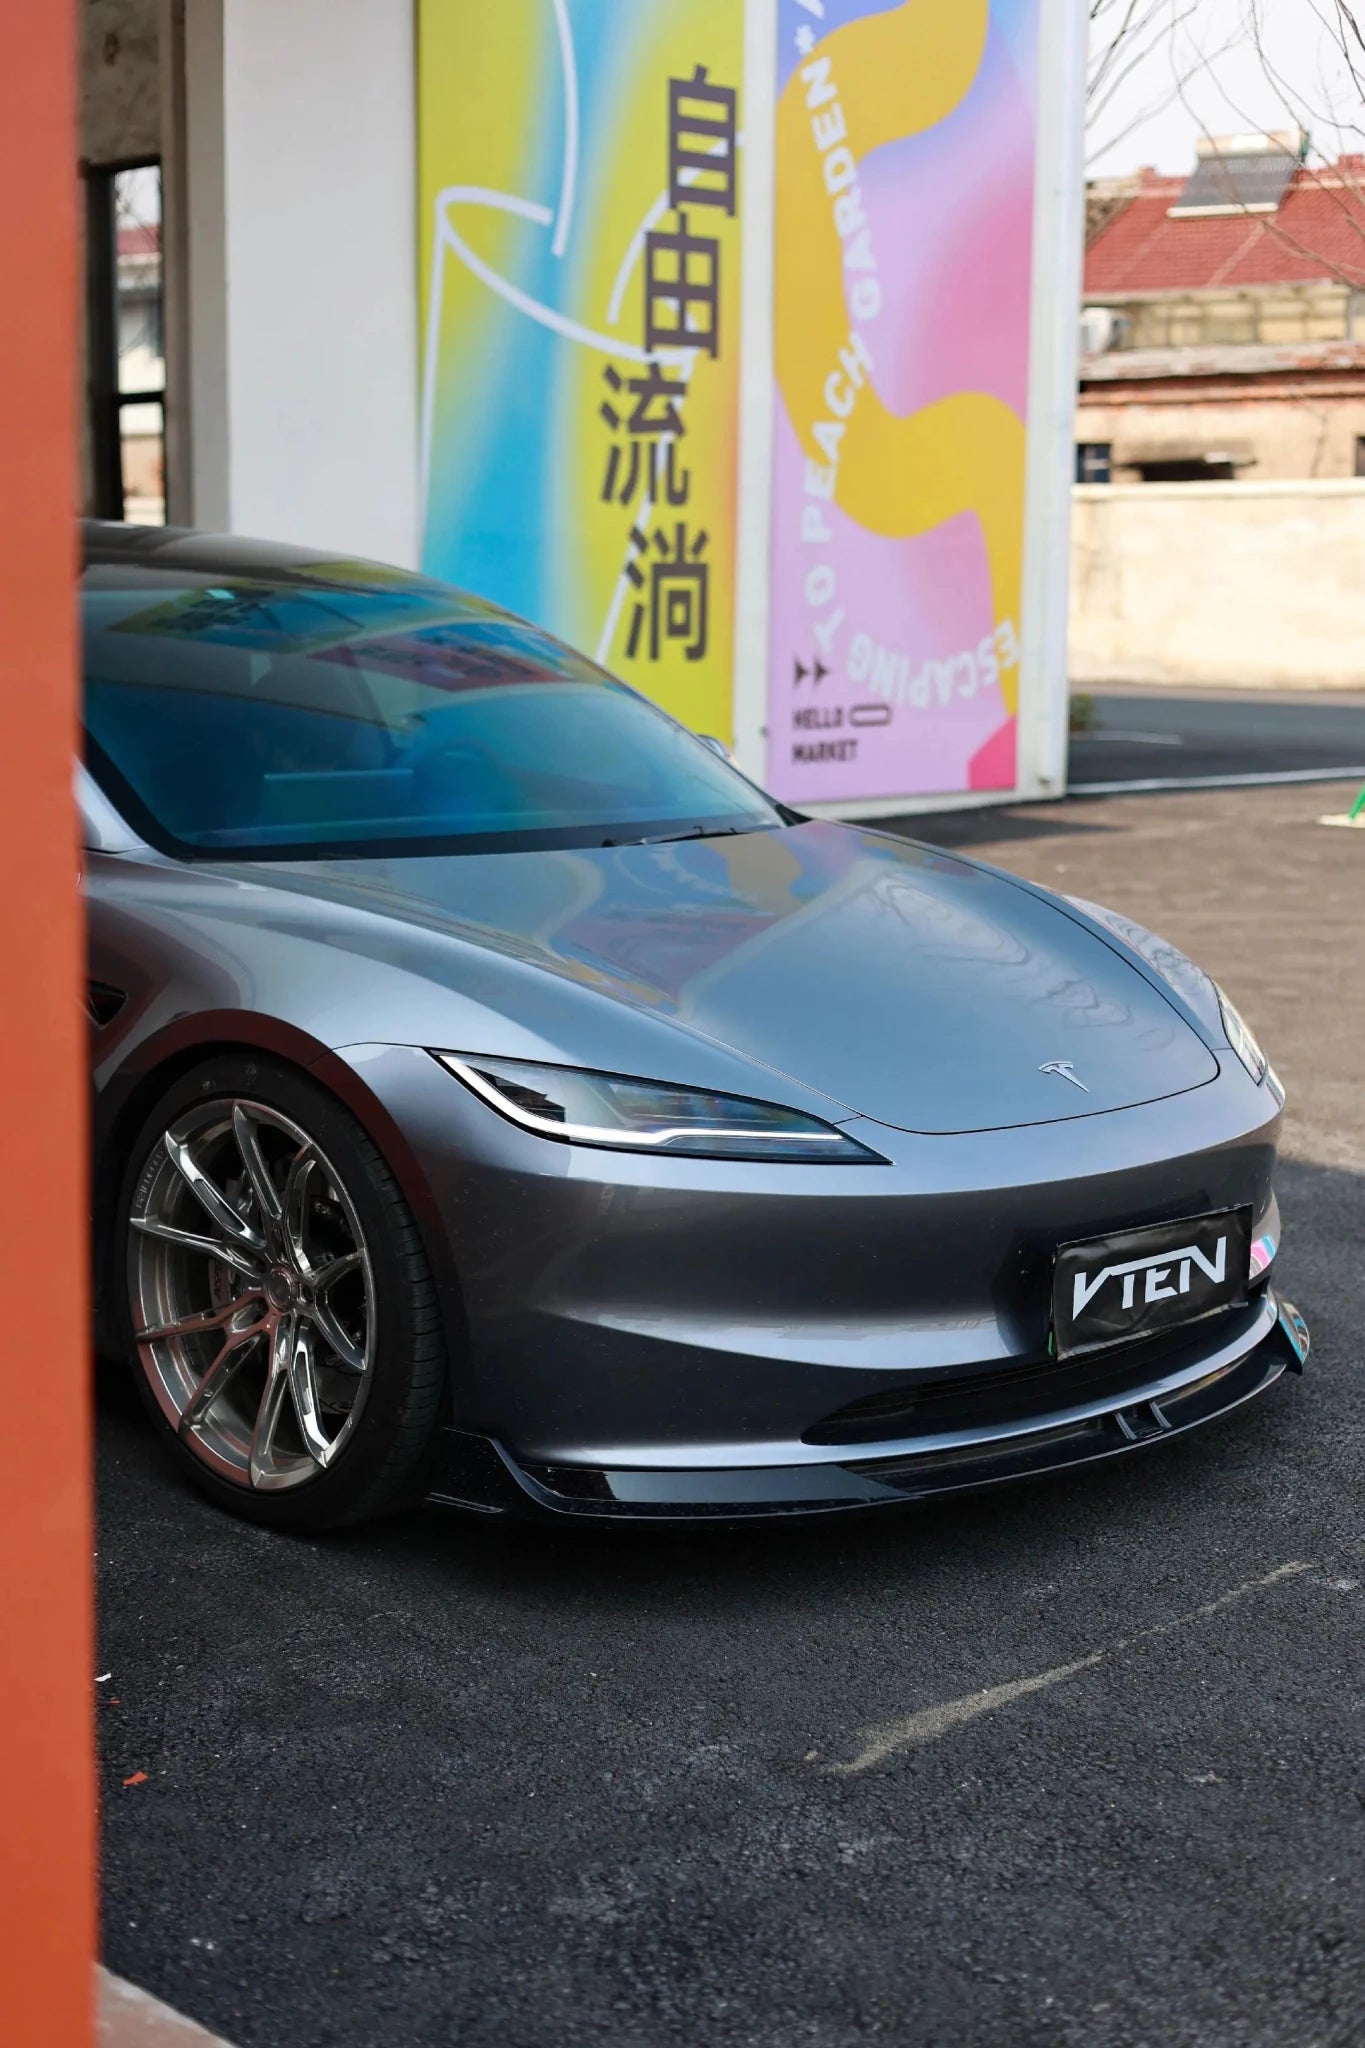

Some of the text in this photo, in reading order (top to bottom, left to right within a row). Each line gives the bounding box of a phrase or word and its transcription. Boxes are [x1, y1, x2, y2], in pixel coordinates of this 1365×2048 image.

[599, 64, 738, 663] 自由流淌
[800, 56, 1019, 708] ESCAPING TO PEACH GARDEN
[1072, 1236, 1227, 1321] VTEN
